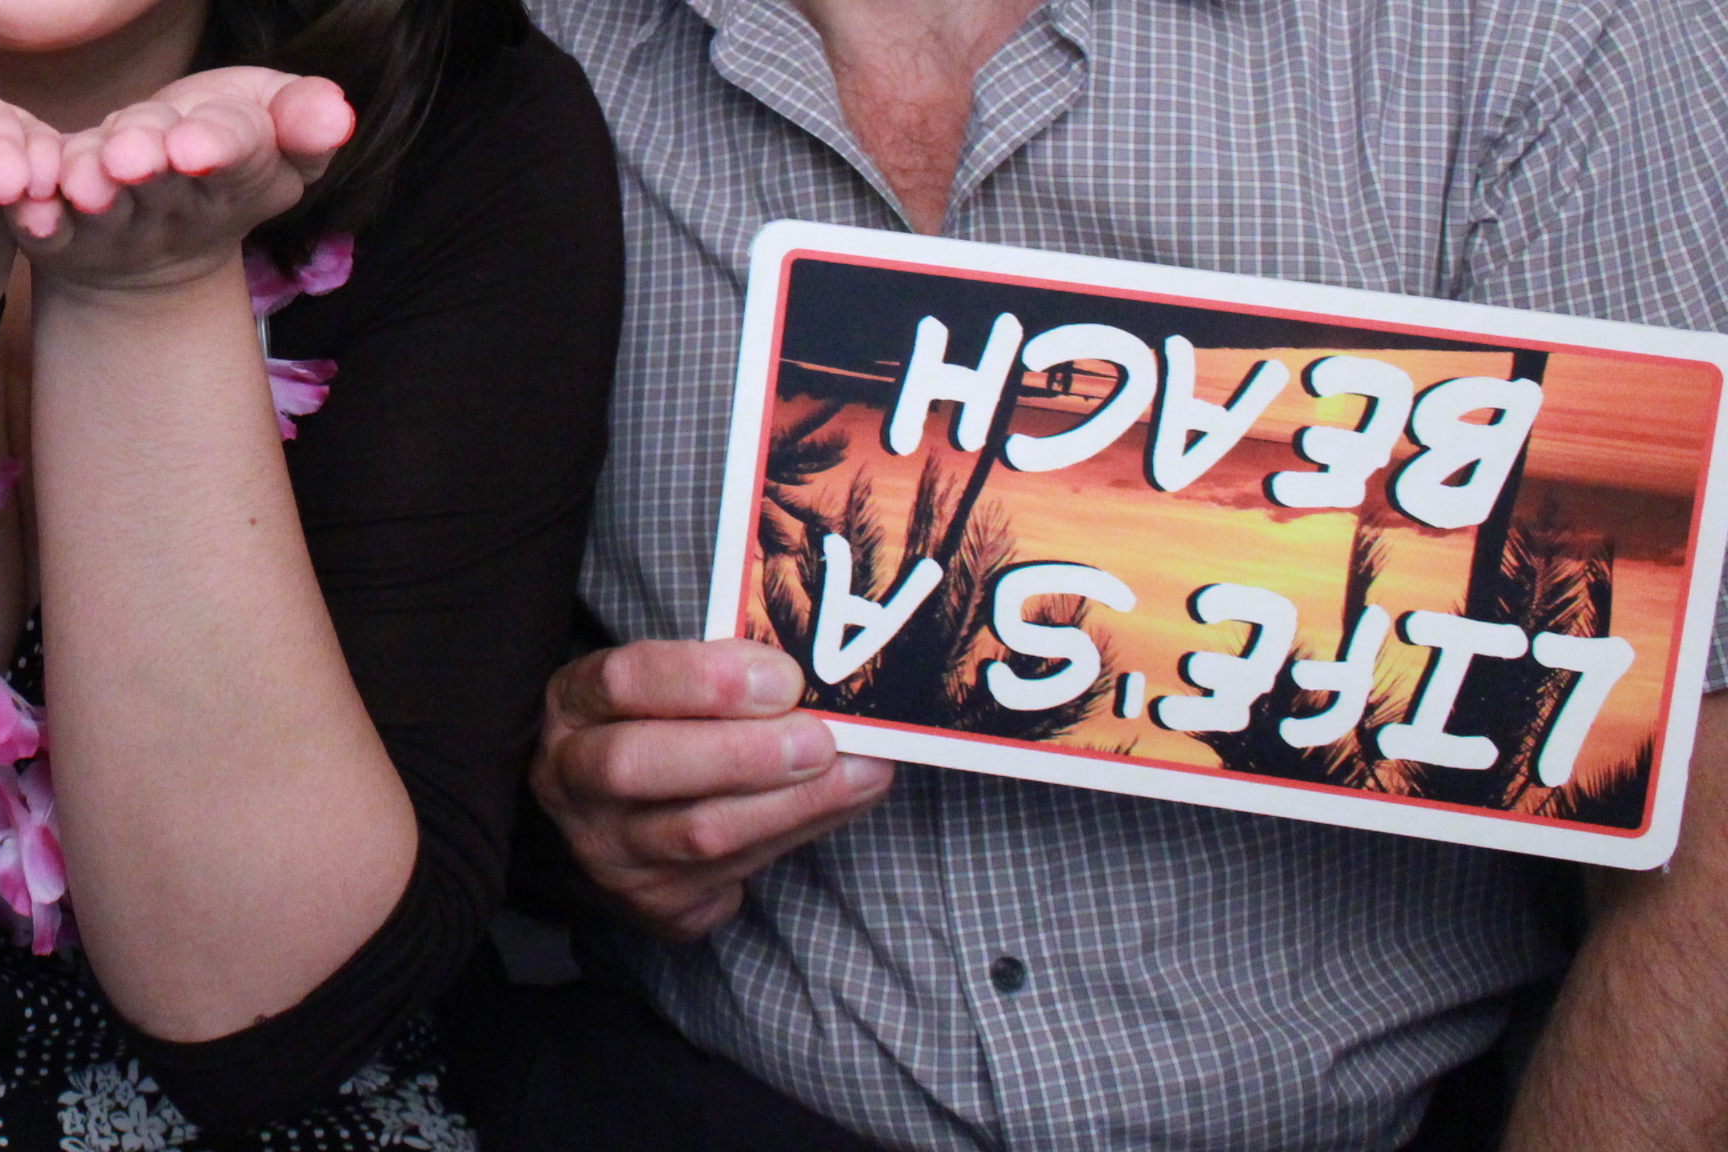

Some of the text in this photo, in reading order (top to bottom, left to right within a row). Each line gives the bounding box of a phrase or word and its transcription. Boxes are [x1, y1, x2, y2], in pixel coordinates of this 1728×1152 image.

[888, 312, 1543, 529] BEACH
[813, 532, 1636, 788] LIFE'S A
